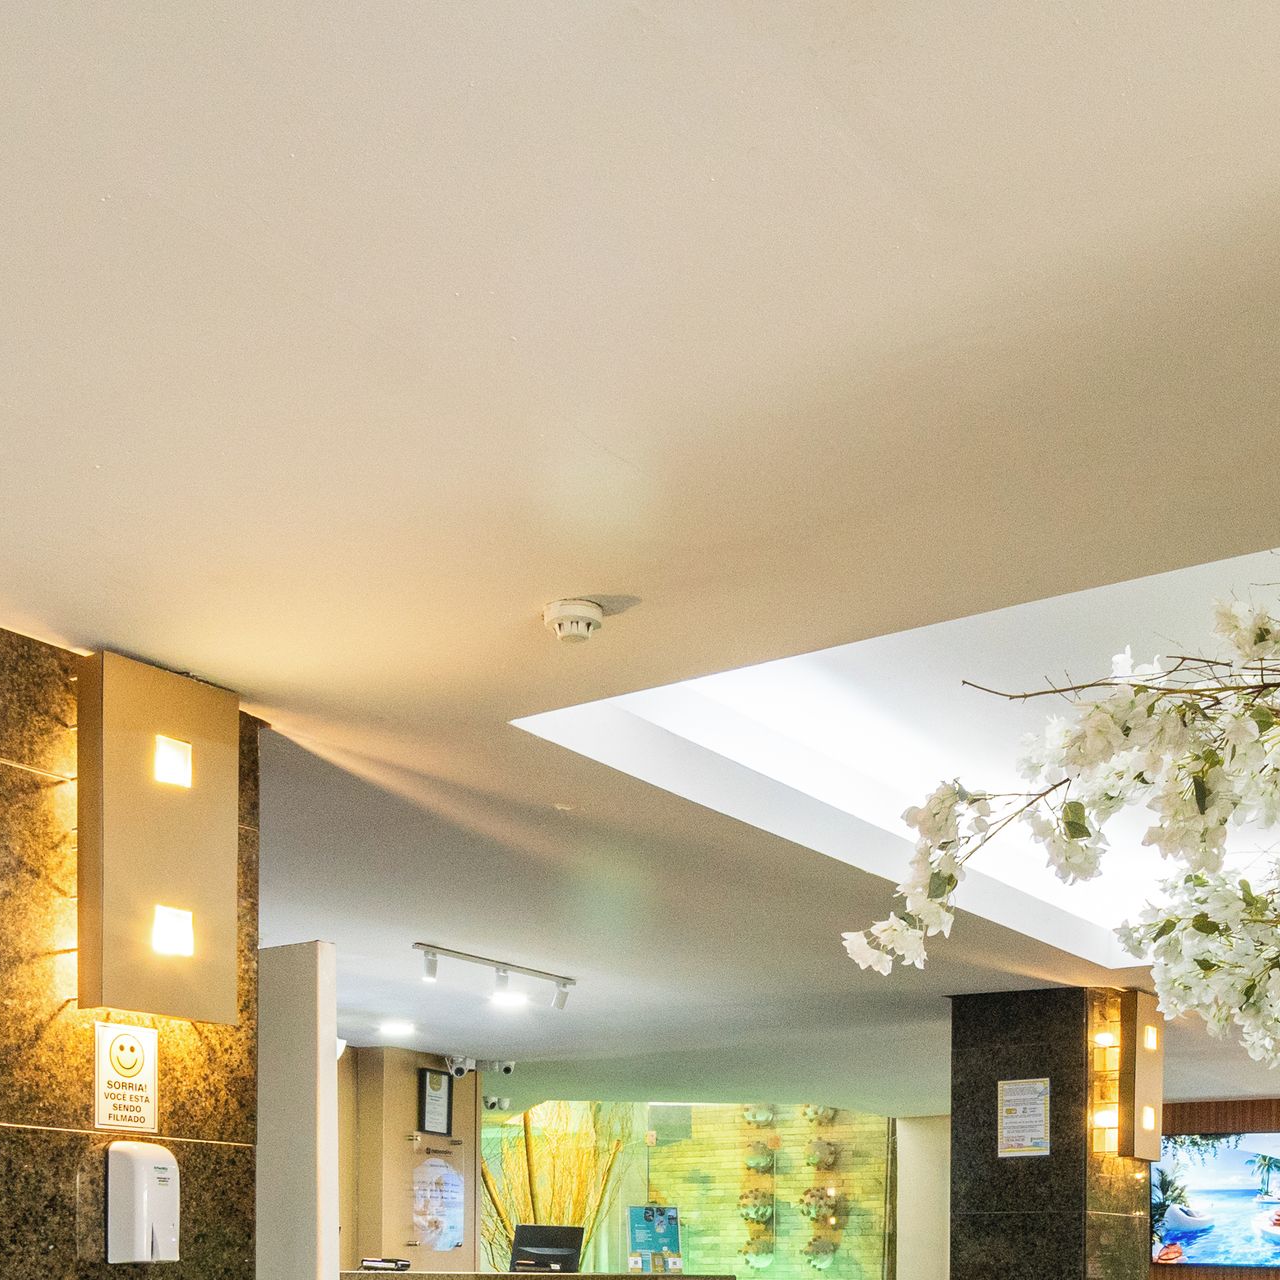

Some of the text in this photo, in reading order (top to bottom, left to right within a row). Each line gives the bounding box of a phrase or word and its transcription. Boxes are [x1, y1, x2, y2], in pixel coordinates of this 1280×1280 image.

[106, 1080, 148, 1092] SORRIA!
[112, 1103, 142, 1113] SENDO
[108, 1113, 146, 1124] FILMADO
